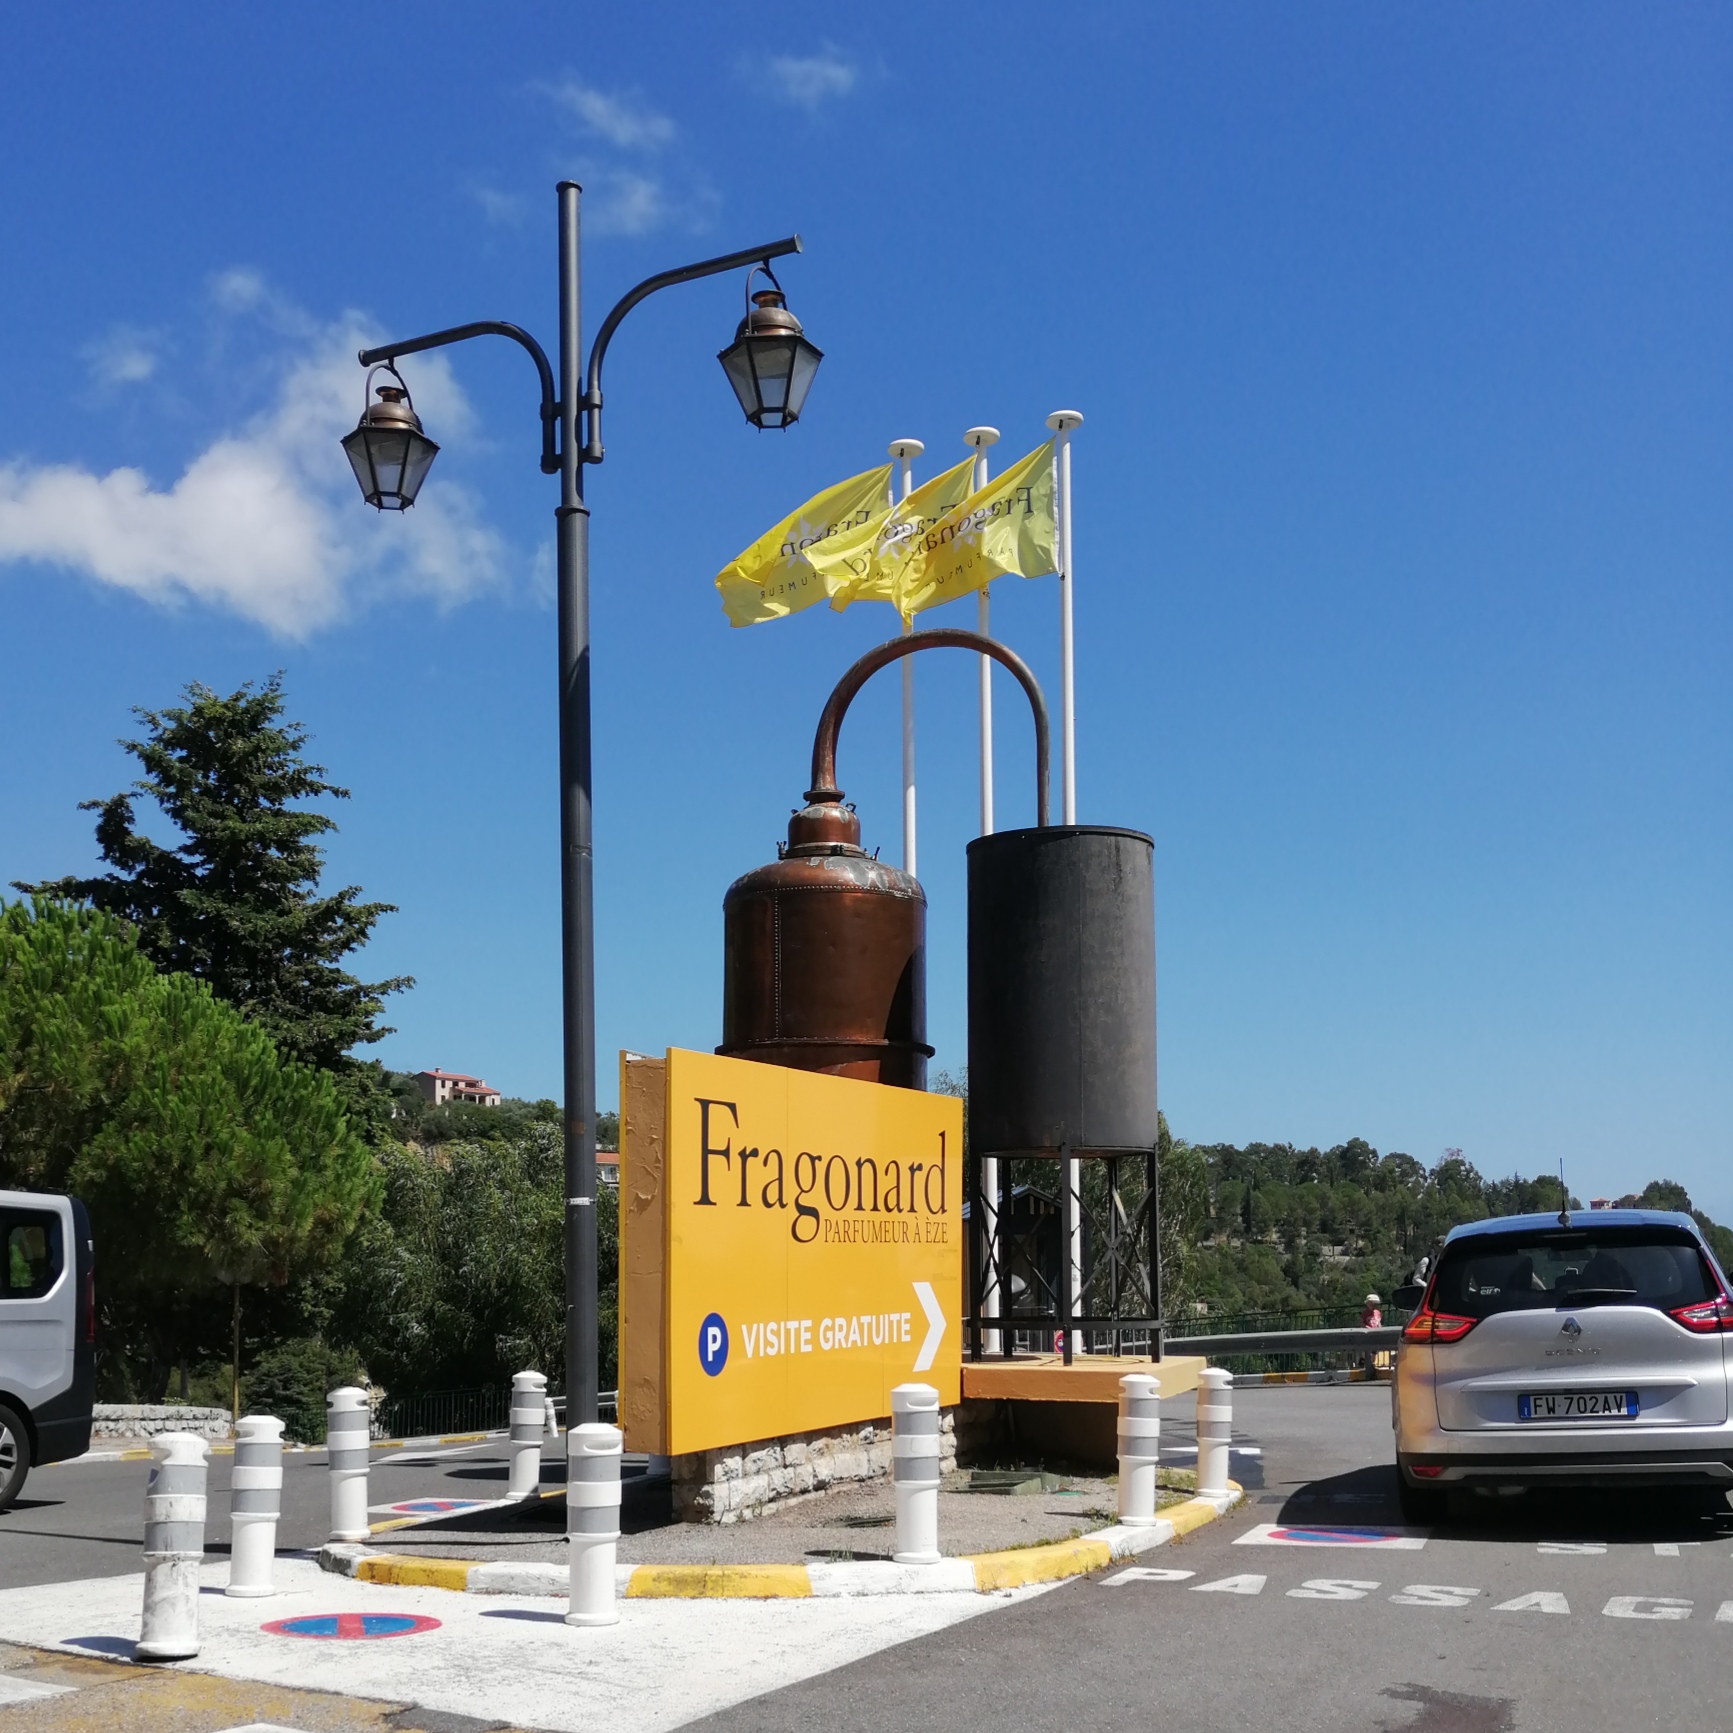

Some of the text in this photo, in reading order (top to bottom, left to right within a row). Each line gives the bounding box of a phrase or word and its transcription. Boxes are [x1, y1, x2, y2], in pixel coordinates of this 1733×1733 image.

[693, 1097, 948, 1243] Fragonard
[824, 1216, 948, 1243] PARFUMEUR À ÈZE
[707, 1312, 911, 1361] P VISITE GRATUITE
[1533, 1397, 1556, 1415] FW
[1564, 1395, 1624, 1415] 702AV
[1099, 1566, 1733, 1623] PASSAG
